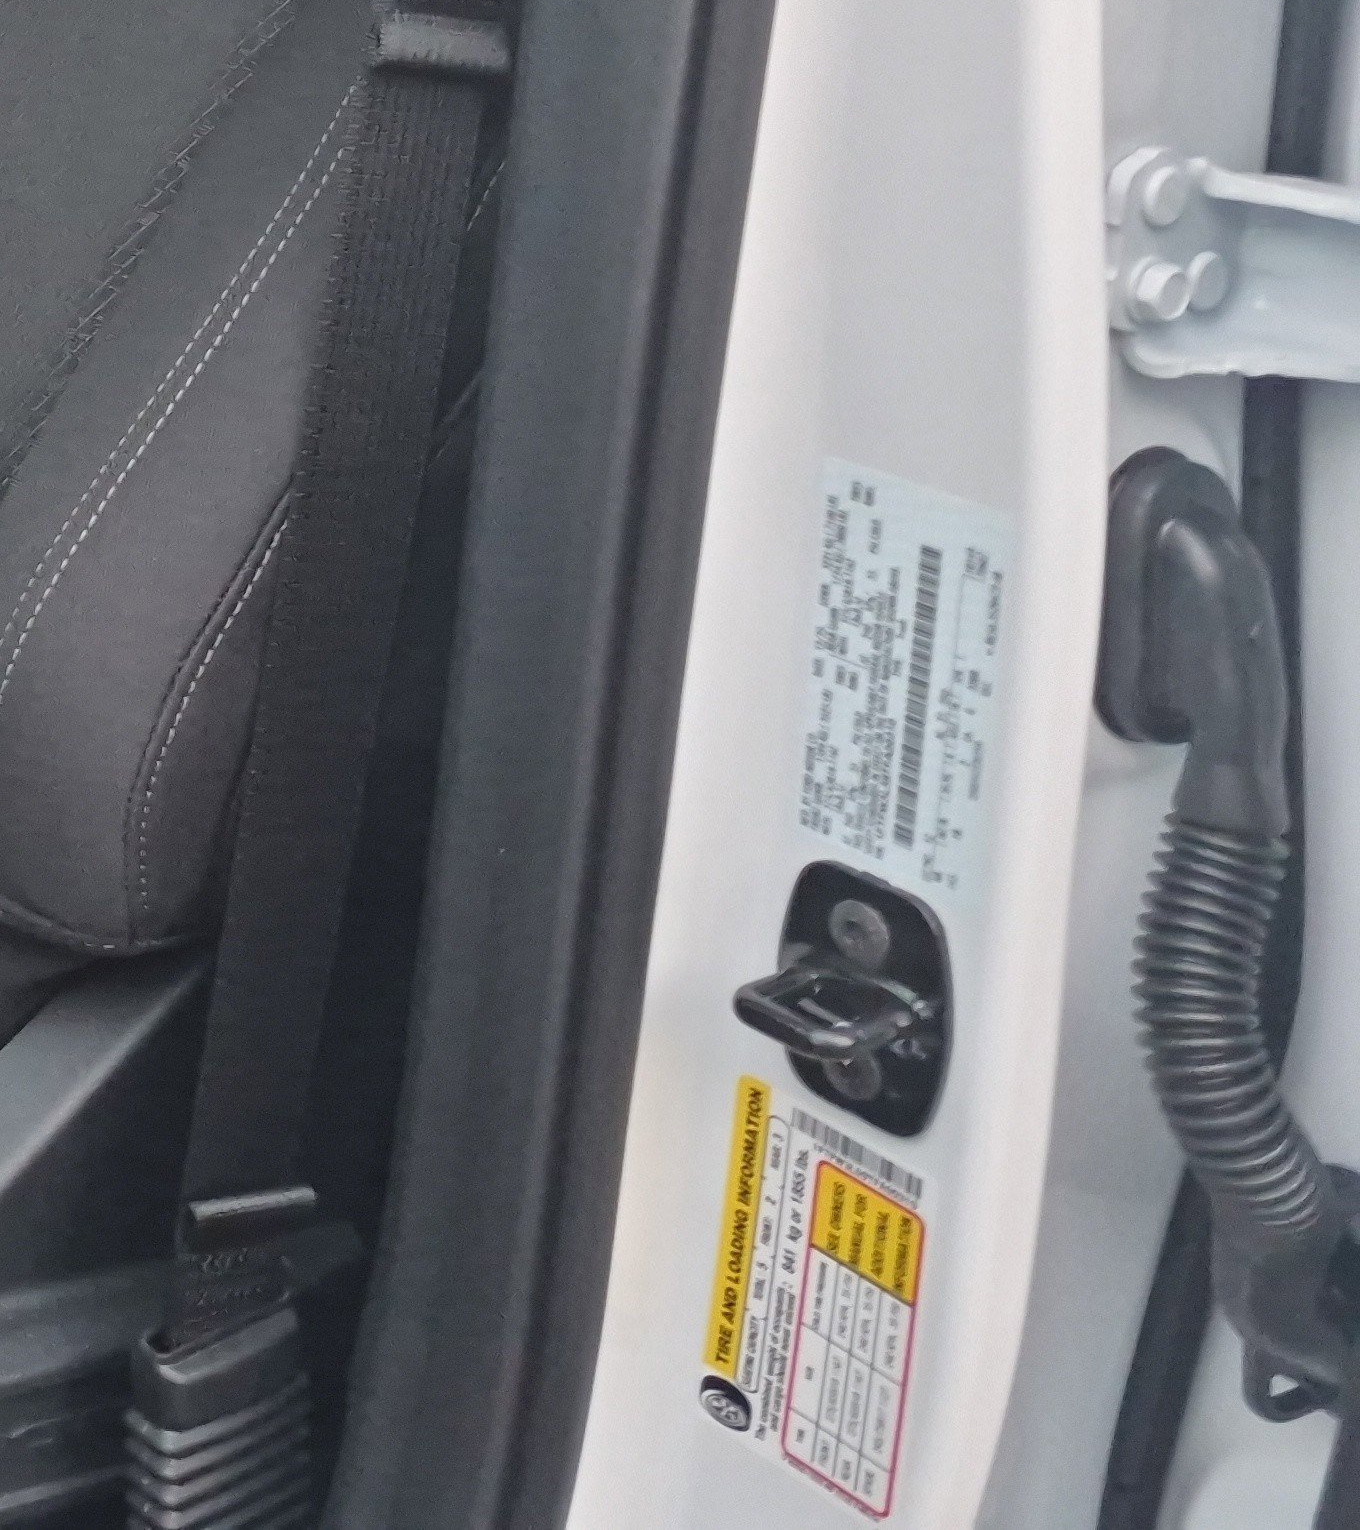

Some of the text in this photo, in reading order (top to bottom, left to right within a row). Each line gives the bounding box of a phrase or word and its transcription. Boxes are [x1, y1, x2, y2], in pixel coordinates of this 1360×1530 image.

[715, 1087, 762, 1364] TIRE AND LOADING INFORMATION
